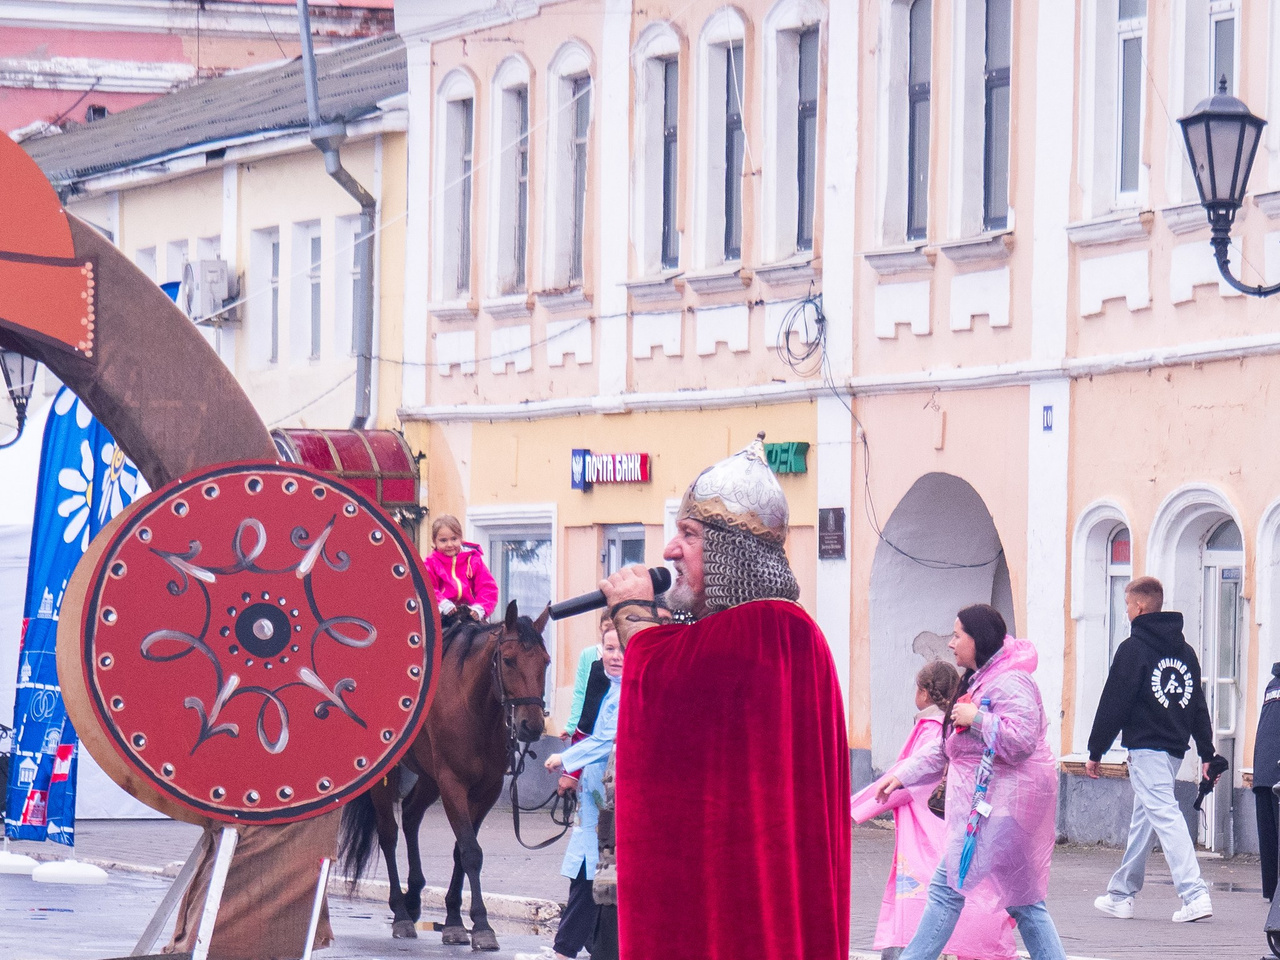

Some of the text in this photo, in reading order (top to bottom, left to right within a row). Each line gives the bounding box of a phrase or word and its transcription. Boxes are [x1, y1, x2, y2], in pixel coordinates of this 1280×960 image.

[1044, 410, 1052, 427] 10
[585, 453, 642, 483] ПОЧТА БАНК
[1151, 657, 1193, 709] RUSSIAN CURLING SCHOOL
